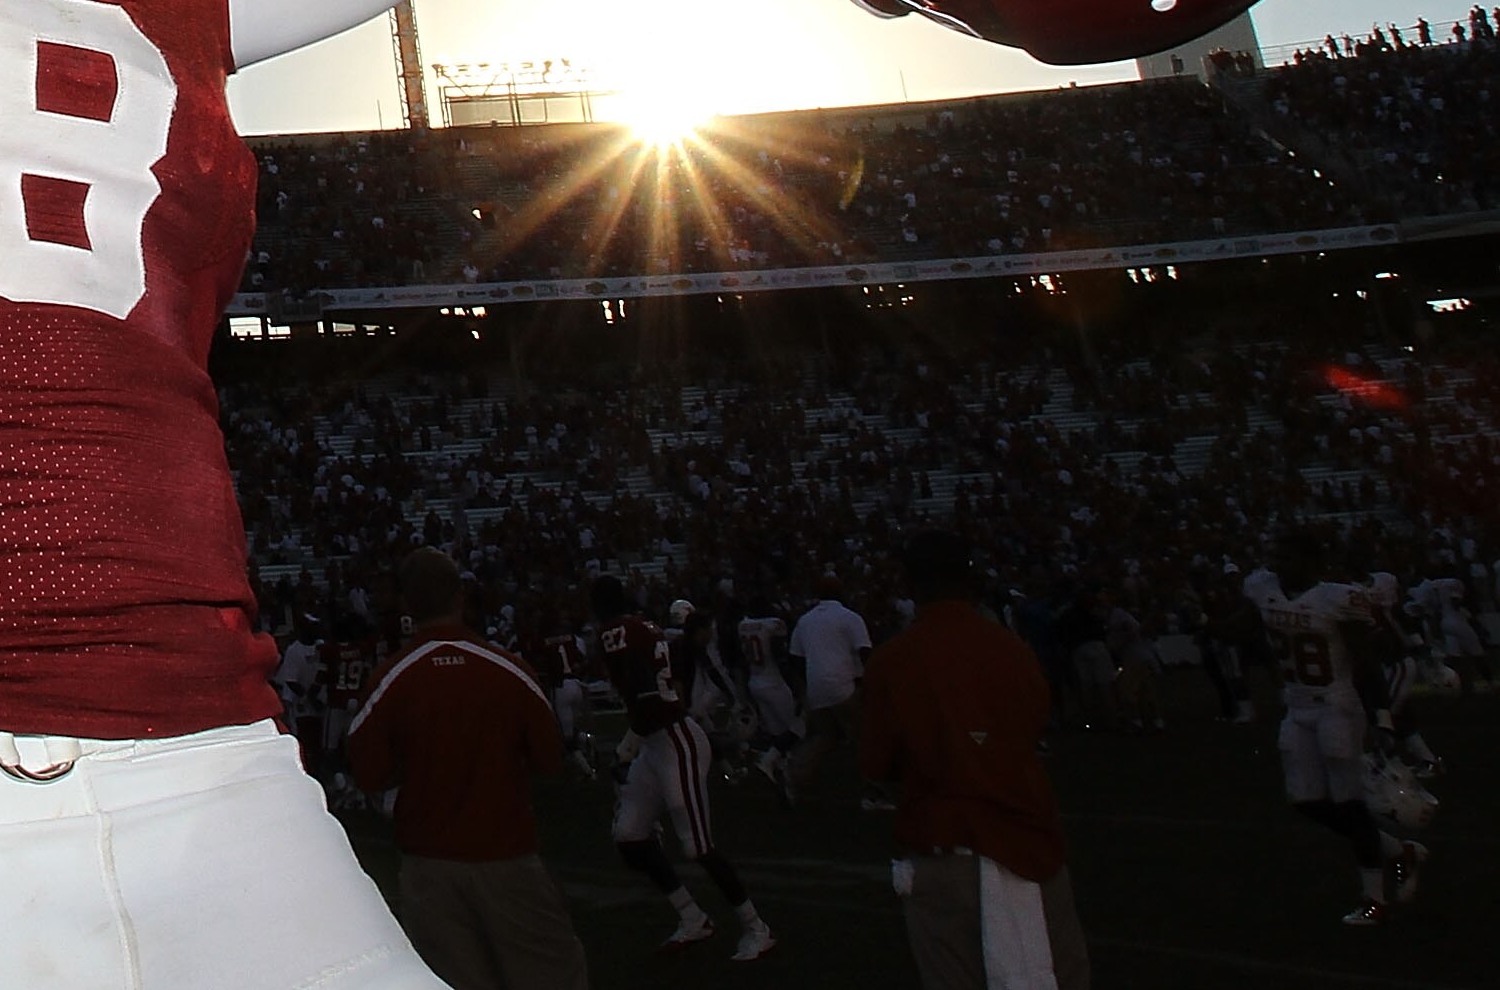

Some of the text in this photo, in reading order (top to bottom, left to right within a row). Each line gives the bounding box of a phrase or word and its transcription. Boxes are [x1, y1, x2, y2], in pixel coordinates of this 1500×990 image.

[601, 626, 628, 653] 27
[431, 655, 466, 667] TEXAS
[336, 660, 364, 690] 19
